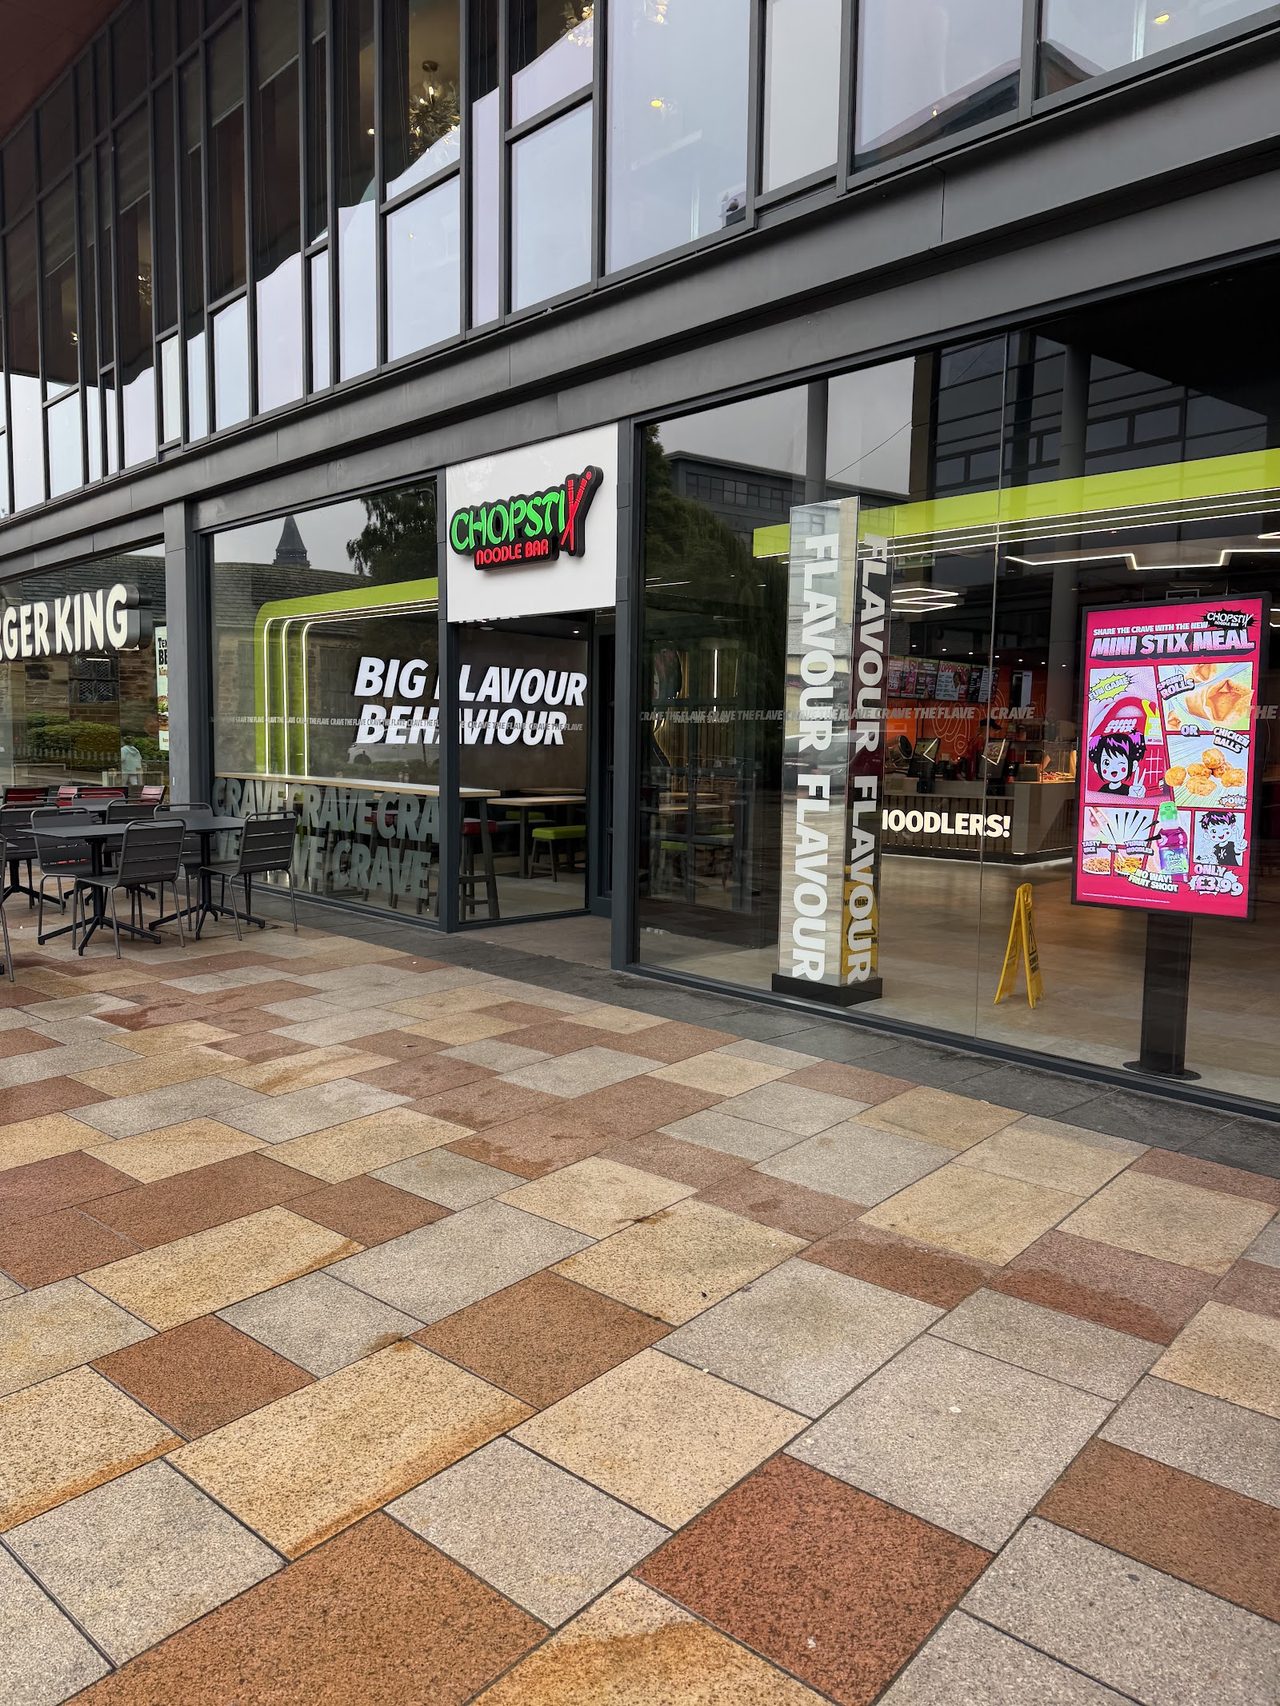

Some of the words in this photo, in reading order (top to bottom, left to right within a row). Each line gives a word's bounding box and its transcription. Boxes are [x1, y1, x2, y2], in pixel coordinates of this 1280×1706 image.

[476, 543, 522, 566] NOODLE
[525, 538, 549, 558] BAR
[54, 583, 128, 654] KING
[1093, 628, 1116, 636] SHARE
[1116, 626, 1131, 634] THE
[1131, 625, 1154, 633] CRAVE
[1155, 623, 1175, 632] WITH
[1175, 622, 1190, 631] THE
[1190, 621, 1208, 630] NEW
[798, 533, 839, 753] FLAVOUR
[855, 533, 888, 754] FLAVOUR
[1090, 635, 1138, 657] MINI
[1140, 632, 1190, 655] STIX
[1193, 629, 1255, 652] MEAL
[354, 656, 429, 699] BIG
[1157, 674, 1184, 691] SPRING
[1088, 687, 1105, 701] FUN
[1104, 677, 1129, 692] GAME
[1160, 679, 1194, 699] ROLLS
[640, 711, 664, 721] CRAVE
[737, 710, 755, 721] THE
[755, 710, 784, 721] FLAVE
[875, 707, 912, 720] CRAVE
[913, 707, 937, 719] THE
[936, 706, 976, 719] FLAVE
[990, 706, 1036, 719] CRAVE
[467, 721, 491, 729] CRAVE
[563, 723, 583, 731] FLAVE
[1181, 725, 1199, 736] OR
[1213, 727, 1250, 747] CHICKEN
[1214, 736, 1242, 753] BALLS
[333, 839, 432, 900] CRAVE
[793, 774, 831, 982] FLAVOUR
[1136, 868, 1148, 878] NO
[1149, 872, 1173, 884] WAY!
[1193, 864, 1227, 877] ONLY
[847, 775, 878, 985] FLAVOUR
[1127, 875, 1150, 888] FRUIT
[1150, 881, 1179, 892] SHOOT
[1196, 876, 1244, 897] £3.99
